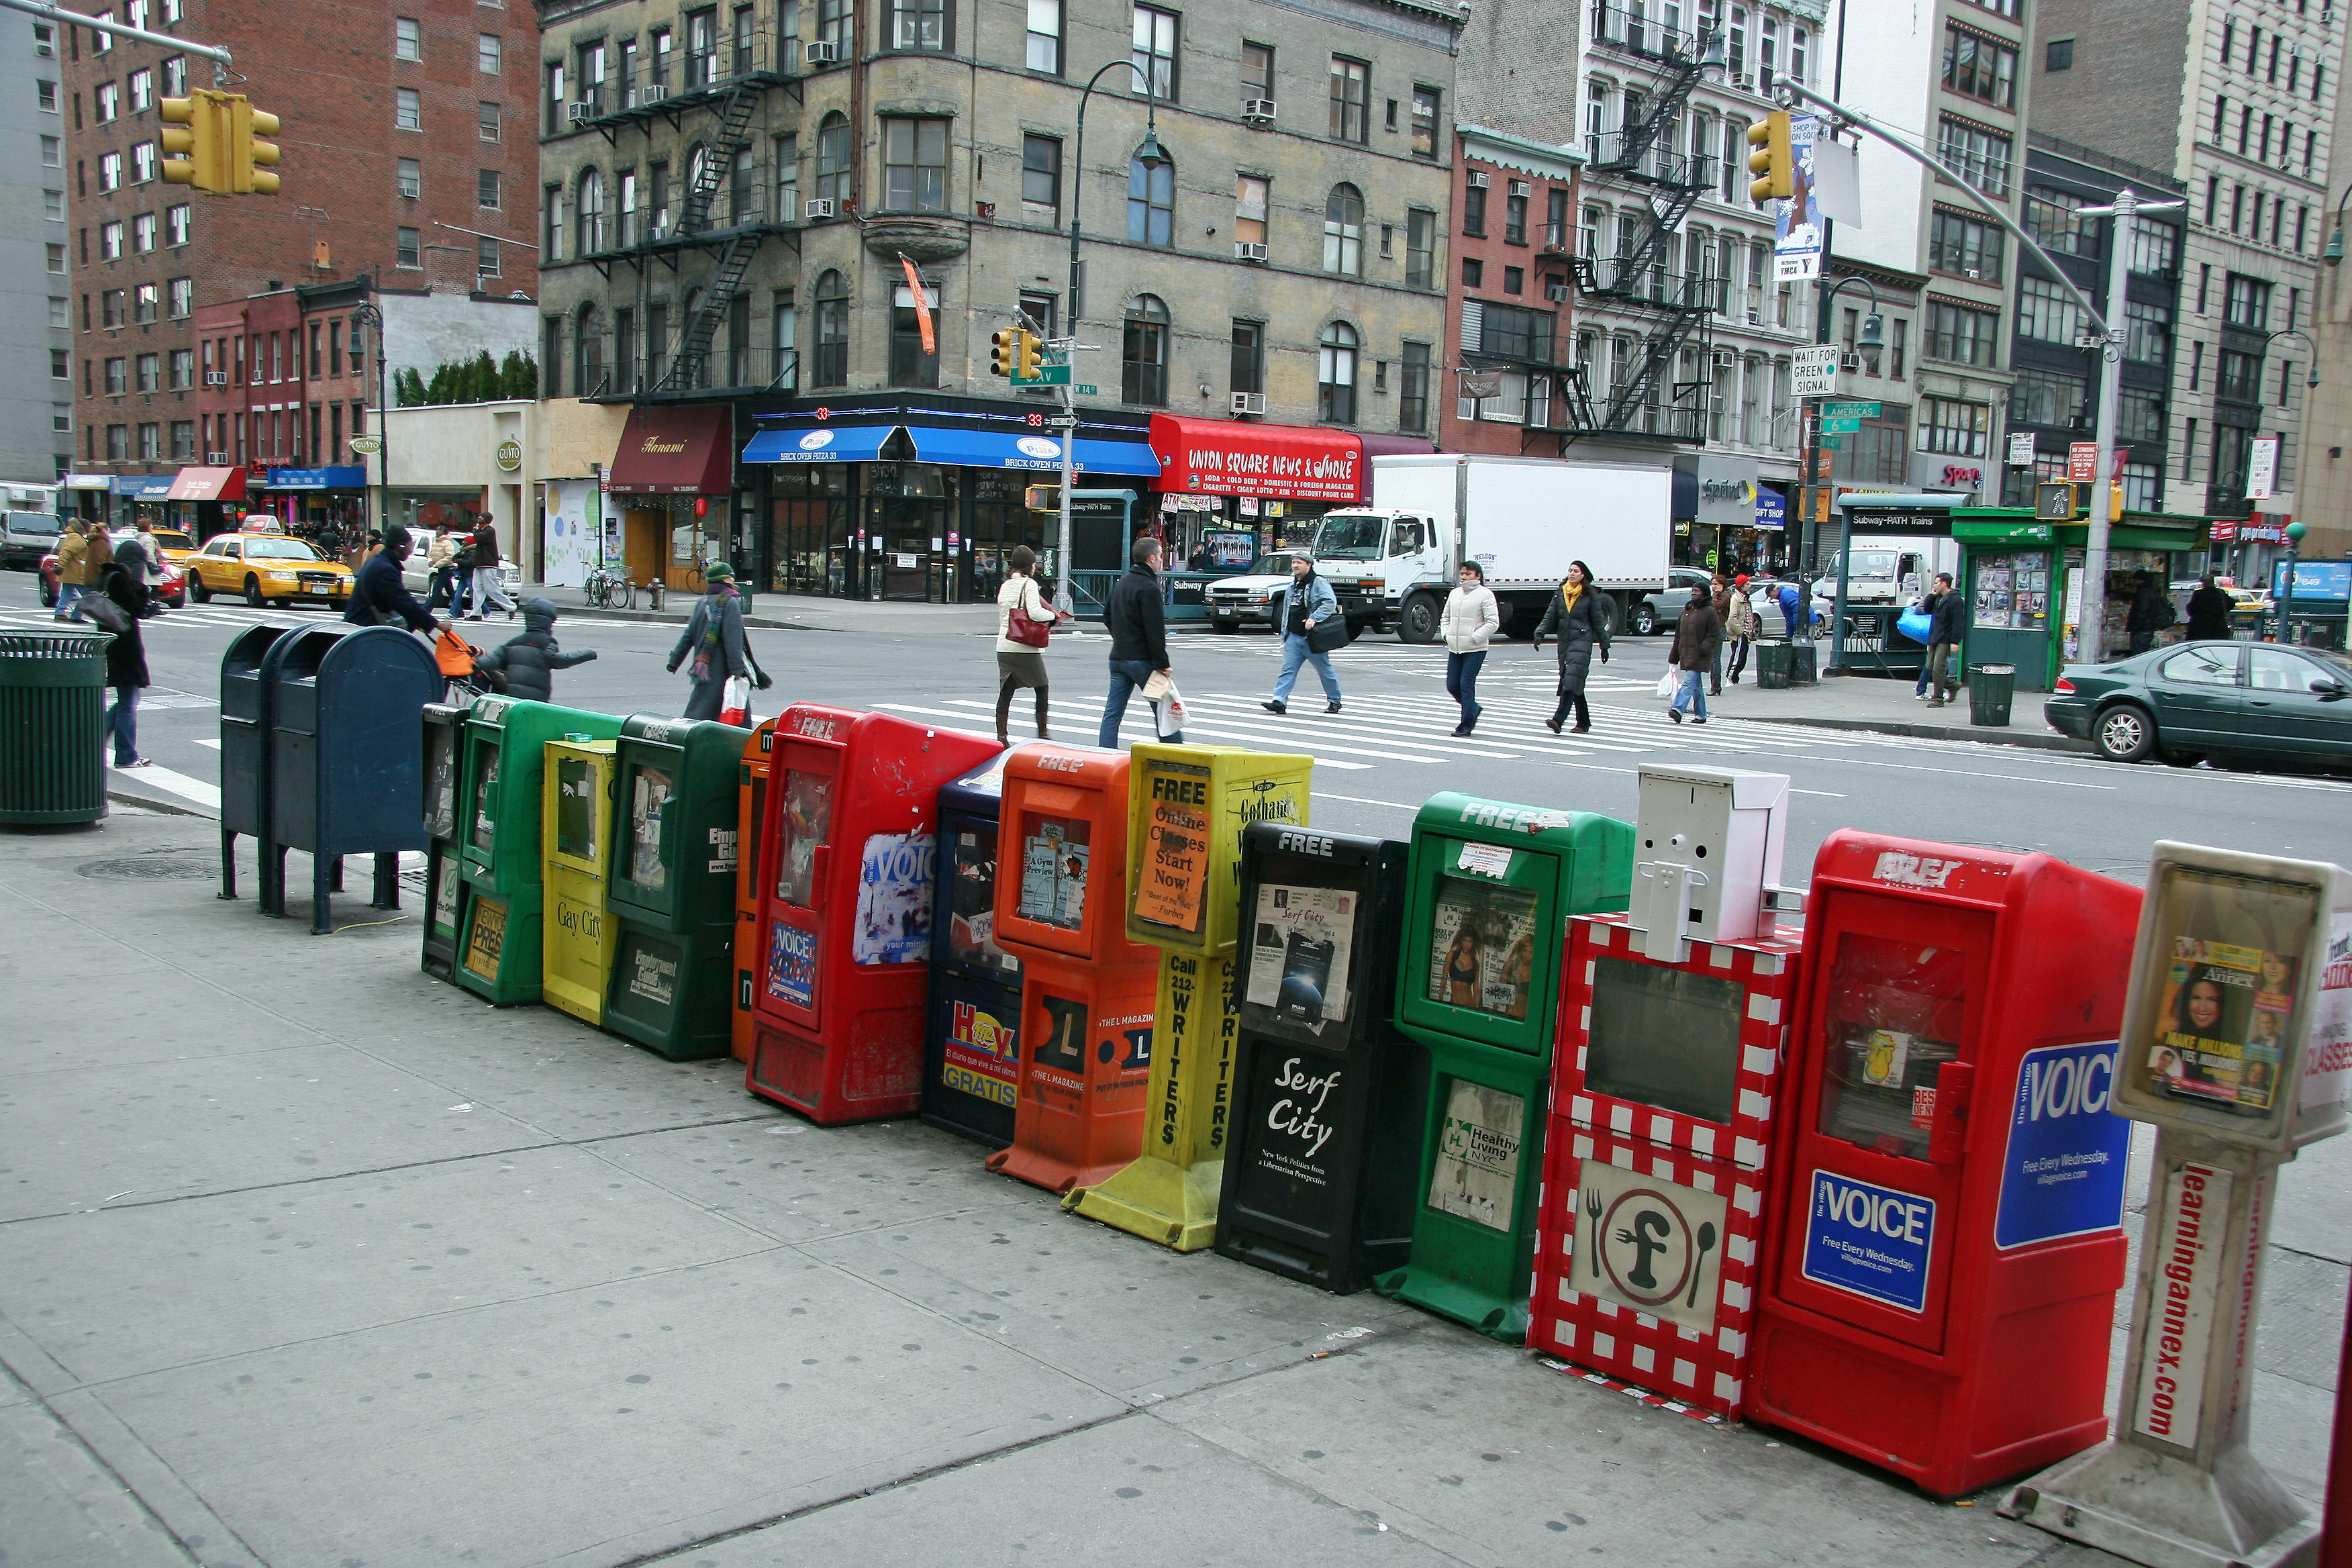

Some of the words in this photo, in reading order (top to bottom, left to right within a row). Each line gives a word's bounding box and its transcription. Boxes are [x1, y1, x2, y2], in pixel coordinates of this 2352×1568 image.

[1780, 266, 1798, 276] YMCA
[1794, 351, 1814, 362] WAIT
[1818, 350, 1836, 361] FOR
[1794, 365, 1822, 377] GREEN
[1083, 385, 1090, 394] 14
[1798, 381, 1828, 392] SIGNAL
[817, 407, 828, 420] 33
[1028, 413, 1042, 427] 33
[1831, 408, 1873, 416] AMERICAS
[1831, 420, 1839, 431] 6
[356, 441, 379, 449] GUSTO
[499, 444, 520, 460] GUSTO
[641, 436, 687, 453] Hanami
[813, 452, 828, 460] PIZZA
[830, 452, 837, 460] 33
[1005, 458, 1028, 467] BRICK
[1030, 460, 1050, 469] OVEN
[1189, 449, 1224, 470] UNION
[1227, 452, 1269, 475] SQUARE
[1273, 455, 1302, 477] NEWS
[1305, 458, 1312, 478] &
[1314, 454, 1353, 479] SMOKE
[1203, 483, 1232, 492] CIGARETTE
[1264, 479, 1292, 487] DOMESTIC
[1325, 483, 1354, 491] MAGAZINE
[1702, 479, 1741, 503] Sprint
[1163, 493, 1179, 505] ATM
[1242, 497, 1257, 509] ATM
[1755, 508, 1767, 517] GIFT
[1768, 509, 1783, 518] SHOP
[1853, 516, 1907, 526] Subway-PATH
[1910, 517, 1932, 526] Trains
[1174, 581, 1202, 591] Subway
[1037, 754, 1085, 773] FREE
[1153, 777, 1206, 805] FREE
[1155, 806, 1206, 832] Online
[1240, 796, 1287, 824] Gotham
[1460, 802, 1539, 833] FREE
[1150, 825, 1206, 853] Classes
[1278, 832, 1334, 858] FREE
[1027, 865, 1055, 875] Preview
[1037, 859, 1052, 868] Gym
[1155, 849, 1193, 872] Start
[1155, 869, 1190, 892] Now!
[1162, 895, 1169, 903] of
[558, 901, 579, 937] Gay
[582, 910, 601, 946] City
[1282, 908, 1304, 925] Serf
[1304, 909, 1324, 925] City
[778, 928, 809, 959] VOICE
[886, 940, 903, 950] your
[1171, 955, 1197, 976] Call
[1171, 975, 1195, 991] 212-
[2202, 966, 2255, 989] Annex
[1101, 1017, 1115, 1027] THE
[1116, 1017, 1120, 1026] L
[1061, 1013, 1078, 1057] L
[2166, 1031, 2197, 1050] MAKE
[2197, 1037, 2243, 1060] MILLIONS
[1137, 1035, 1148, 1059] L
[946, 1048, 951, 1057] El
[952, 1051, 966, 1062] diario
[967, 1057, 977, 1066] que
[978, 1060, 988, 1069] vive
[994, 1065, 1001, 1073] mi
[1001, 1067, 1017, 1079] ritmo.
[1161, 990, 1189, 1145] WRITERS
[2182, 1049, 2198, 1065] YES,
[2198, 1053, 2241, 1072] MILLIONS!
[1034, 1070, 1046, 1081] THE
[1046, 1073, 1052, 1082] L
[1052, 1074, 1084, 1091] MAGAZINE
[1210, 995, 1237, 1148] WRITERS
[945, 1067, 1016, 1106] GRATIS
[1275, 1057, 1342, 1114] Serf
[2017, 1105, 2025, 1124] the
[2022, 1063, 2031, 1102] village
[1914, 1104, 1924, 1115] OF
[1268, 1099, 1332, 1158] City
[1450, 1133, 1463, 1148] HL
[1471, 1138, 1507, 1161] Living
[1473, 1128, 1520, 1153] Healthy
[1262, 1148, 1275, 1159] New
[1276, 1153, 1289, 1164] York
[1289, 1157, 1310, 1171] Politics
[1312, 1164, 1325, 1175] from
[1472, 1150, 1497, 1166] NYC
[2022, 1161, 2038, 1173] Free
[2039, 1157, 2060, 1171] Every
[2061, 1150, 2108, 1167] Wednesday.
[1263, 1160, 1294, 1175] Libertarian
[1295, 1169, 1326, 1186] Perspective
[2037, 1170, 2088, 1185] villagevoice.com
[1826, 1181, 1926, 1245] VOICE
[1822, 1235, 1841, 1249] Free
[1842, 1241, 1865, 1257] Every
[1866, 1247, 1915, 1273] Wednesday.
[1841, 1253, 1893, 1274] villagevoice.com
[2149, 1160, 2214, 1436] learningannex.com
[2221, 1174, 2267, 1440] learningannex.com
